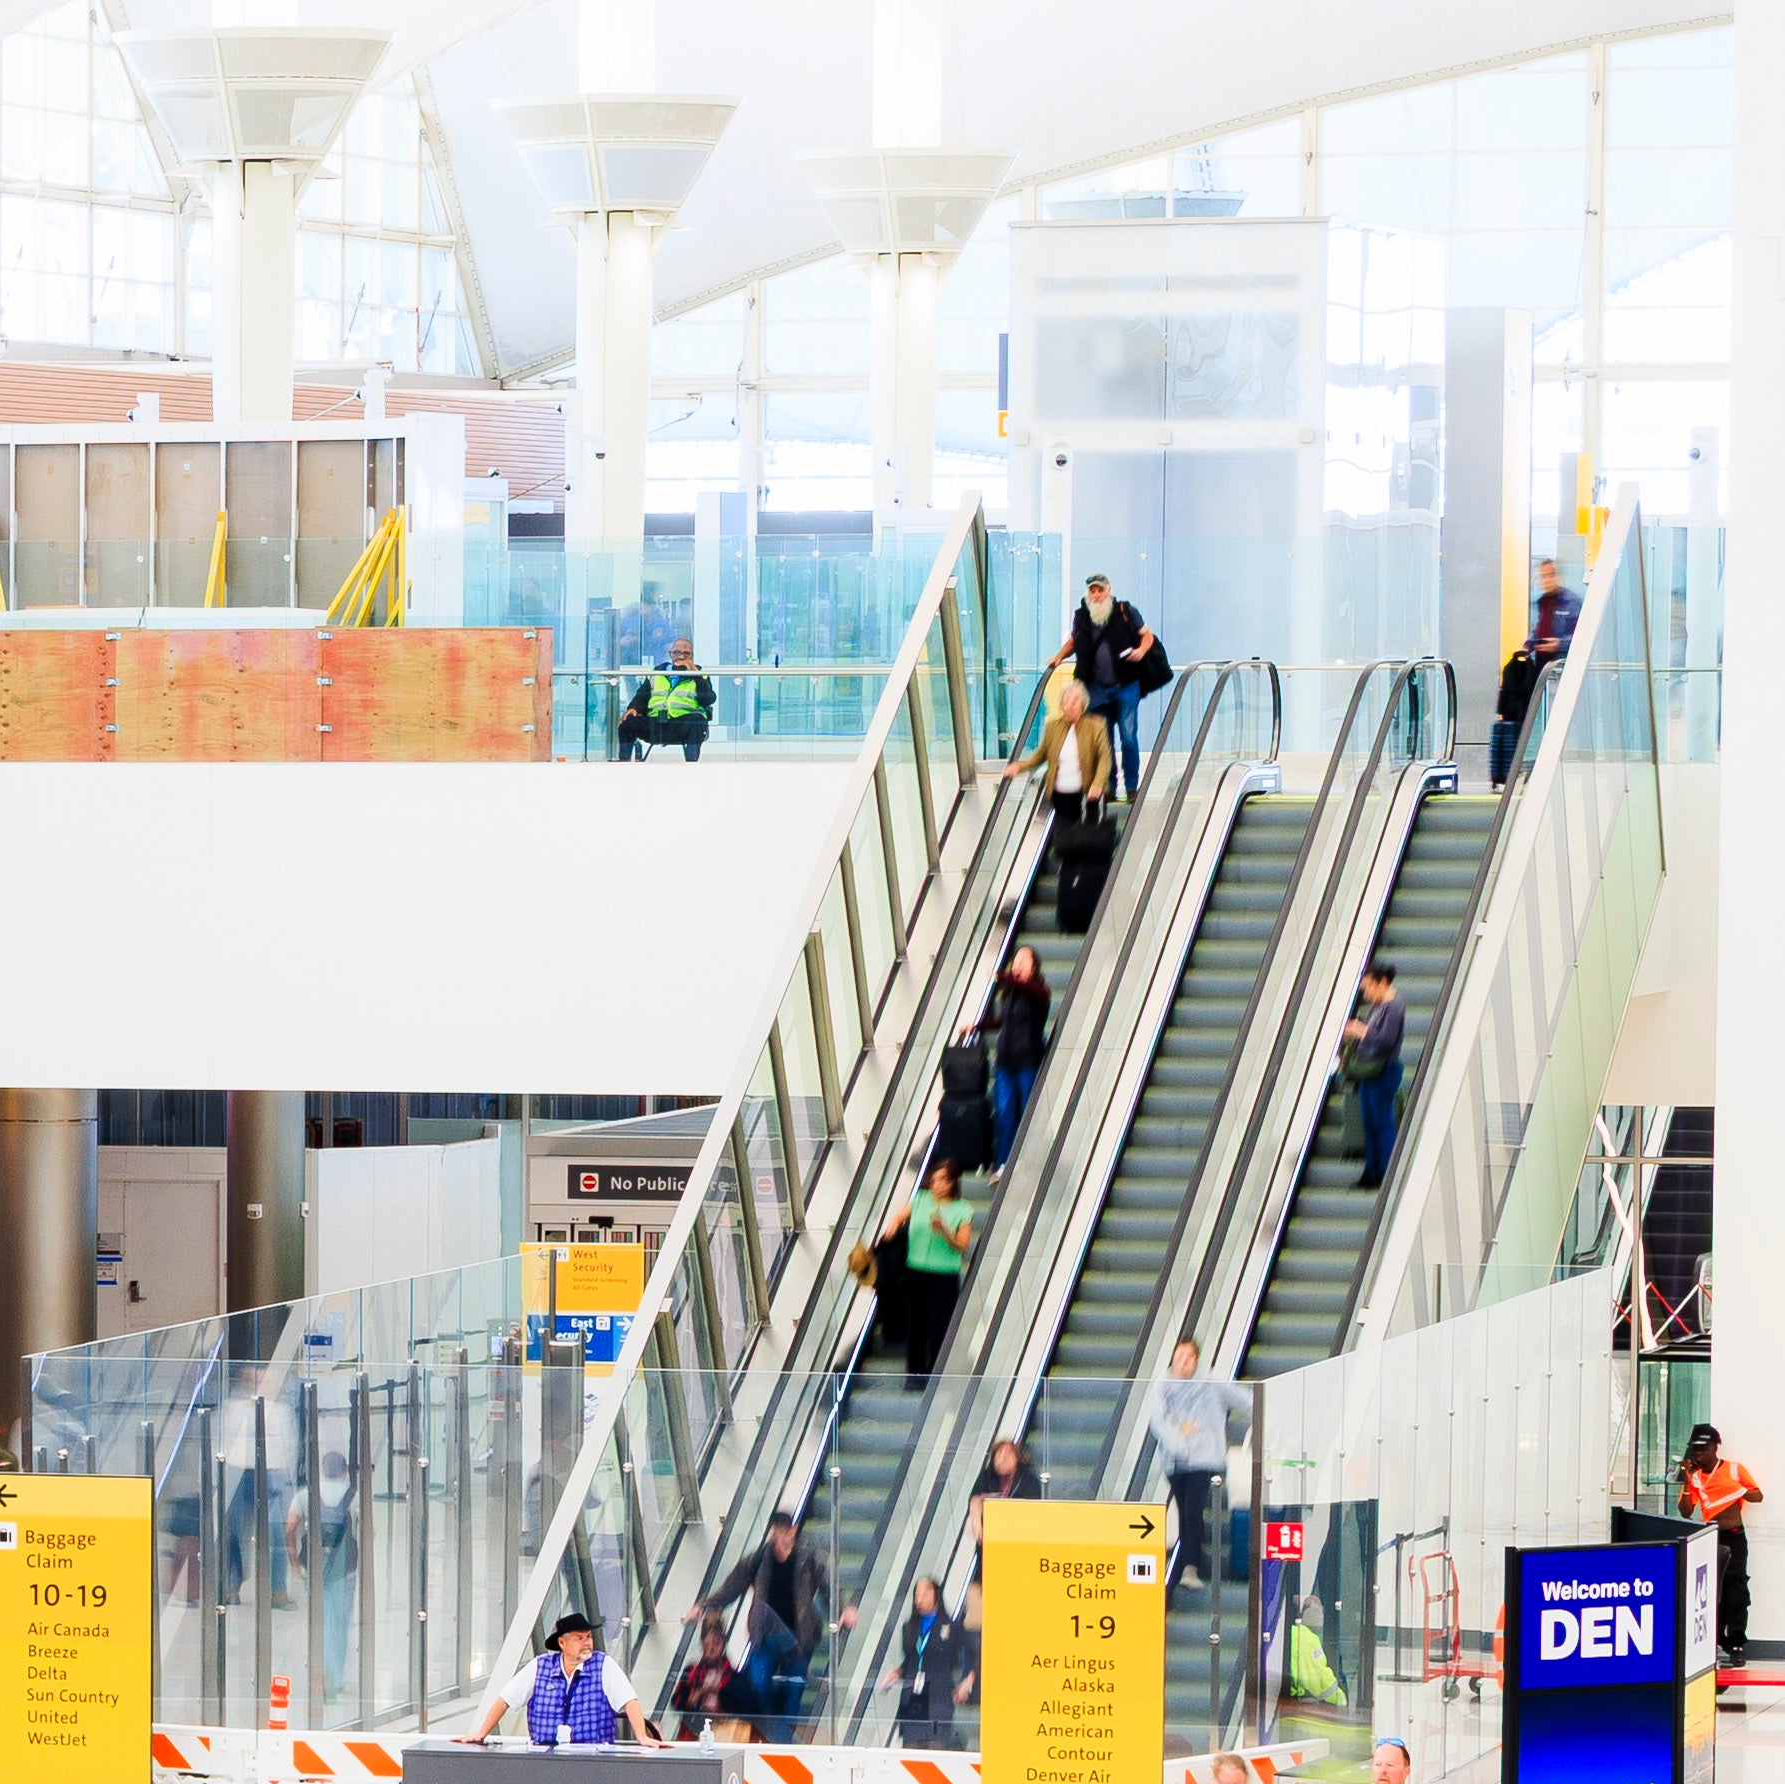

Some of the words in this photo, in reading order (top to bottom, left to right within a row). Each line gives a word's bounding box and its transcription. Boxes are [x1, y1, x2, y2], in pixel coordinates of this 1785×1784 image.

[611, 1177, 632, 1190] No
[638, 1177, 685, 1191] Public
[574, 1250, 597, 1259] West
[573, 1263, 613, 1274] Security
[571, 1319, 593, 1328] East
[25, 1531, 96, 1549] Baggage
[26, 1553, 73, 1569] Claim
[1039, 1558, 1116, 1578] Baggage
[29, 1584, 107, 1608] 10-19
[1066, 1584, 1117, 1600] Claim
[1542, 1581, 1630, 1601] Welcome
[1634, 1578, 1653, 1597] to
[28, 1623, 49, 1638] Air
[53, 1622, 110, 1638] Canada
[1070, 1615, 1116, 1639] 1-9
[1541, 1604, 1653, 1661] DEN
[28, 1645, 78, 1659] Breeze
[1031, 1656, 1059, 1671] Aer
[1064, 1655, 1115, 1675] Lingus
[28, 1666, 67, 1681] Delta
[1062, 1678, 1115, 1693] Alaska
[27, 1688, 55, 1703] Sun
[59, 1690, 119, 1708] Country
[28, 1711, 78, 1724] United
[1040, 1701, 1113, 1719] Allegiant
[1037, 1724, 1114, 1739] American
[28, 1732, 87, 1747] WestJet
[1048, 1747, 1113, 1762] Contour
[1026, 1769, 1084, 1783] Denver
[1089, 1769, 1111, 1783] Air
